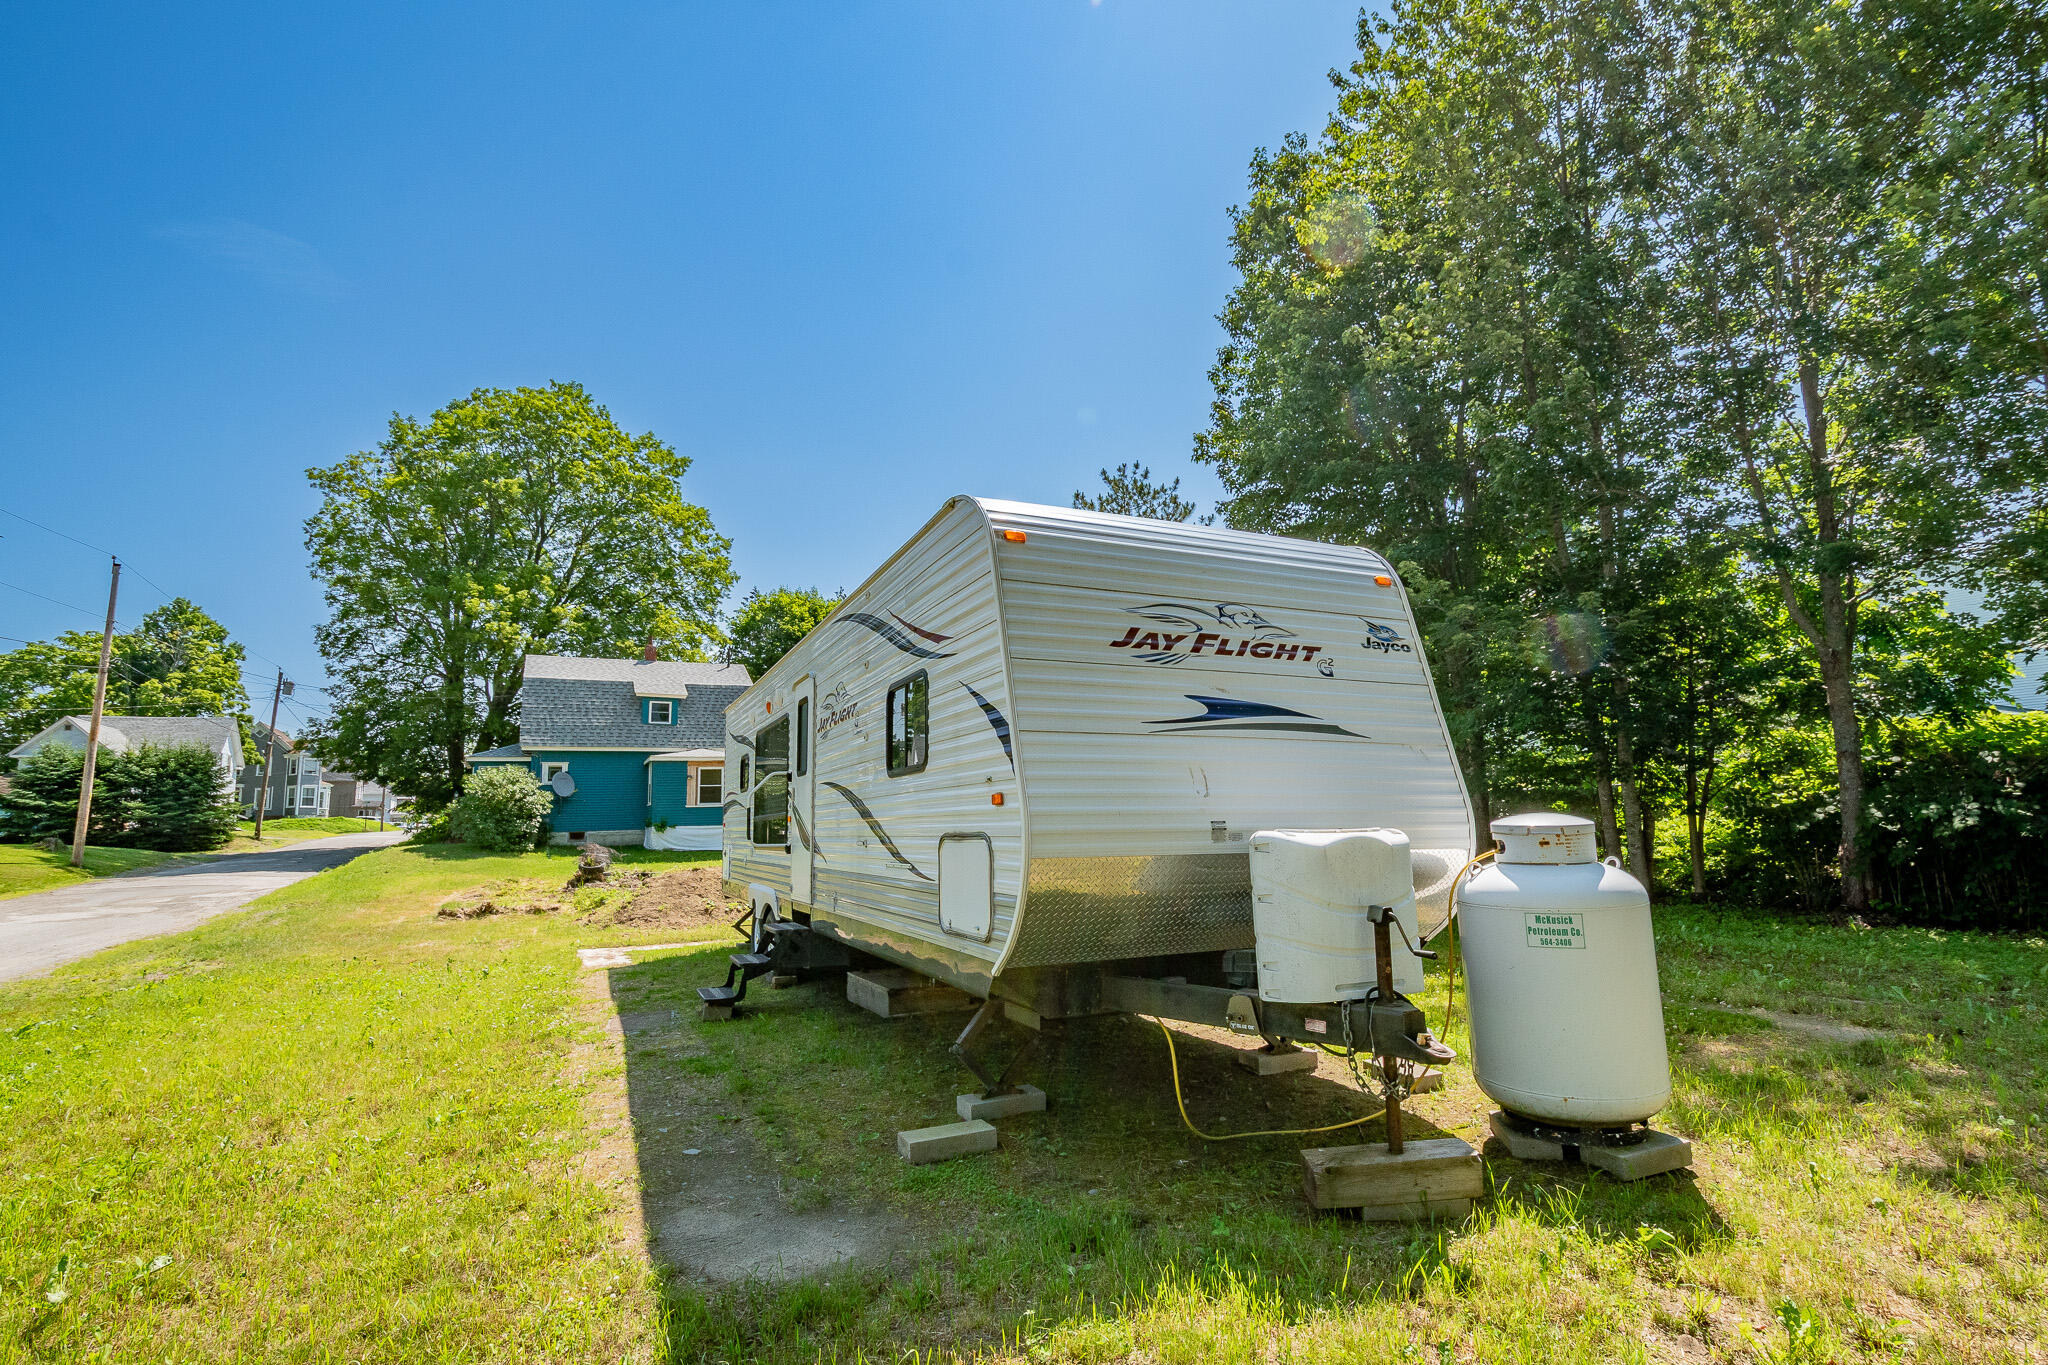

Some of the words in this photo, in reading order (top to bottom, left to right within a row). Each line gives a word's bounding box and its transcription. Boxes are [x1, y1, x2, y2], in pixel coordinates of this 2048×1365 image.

[1109, 627, 1188, 650] JAY
[1190, 633, 1322, 662] FLIGHT
[1361, 637, 1411, 653] Jayco
[817, 716, 830, 733] JAY
[830, 702, 858, 728] FLIGHT
[1535, 915, 1573, 924] McKusick
[1527, 926, 1568, 936] Petroleum
[1570, 927, 1583, 936] Co.
